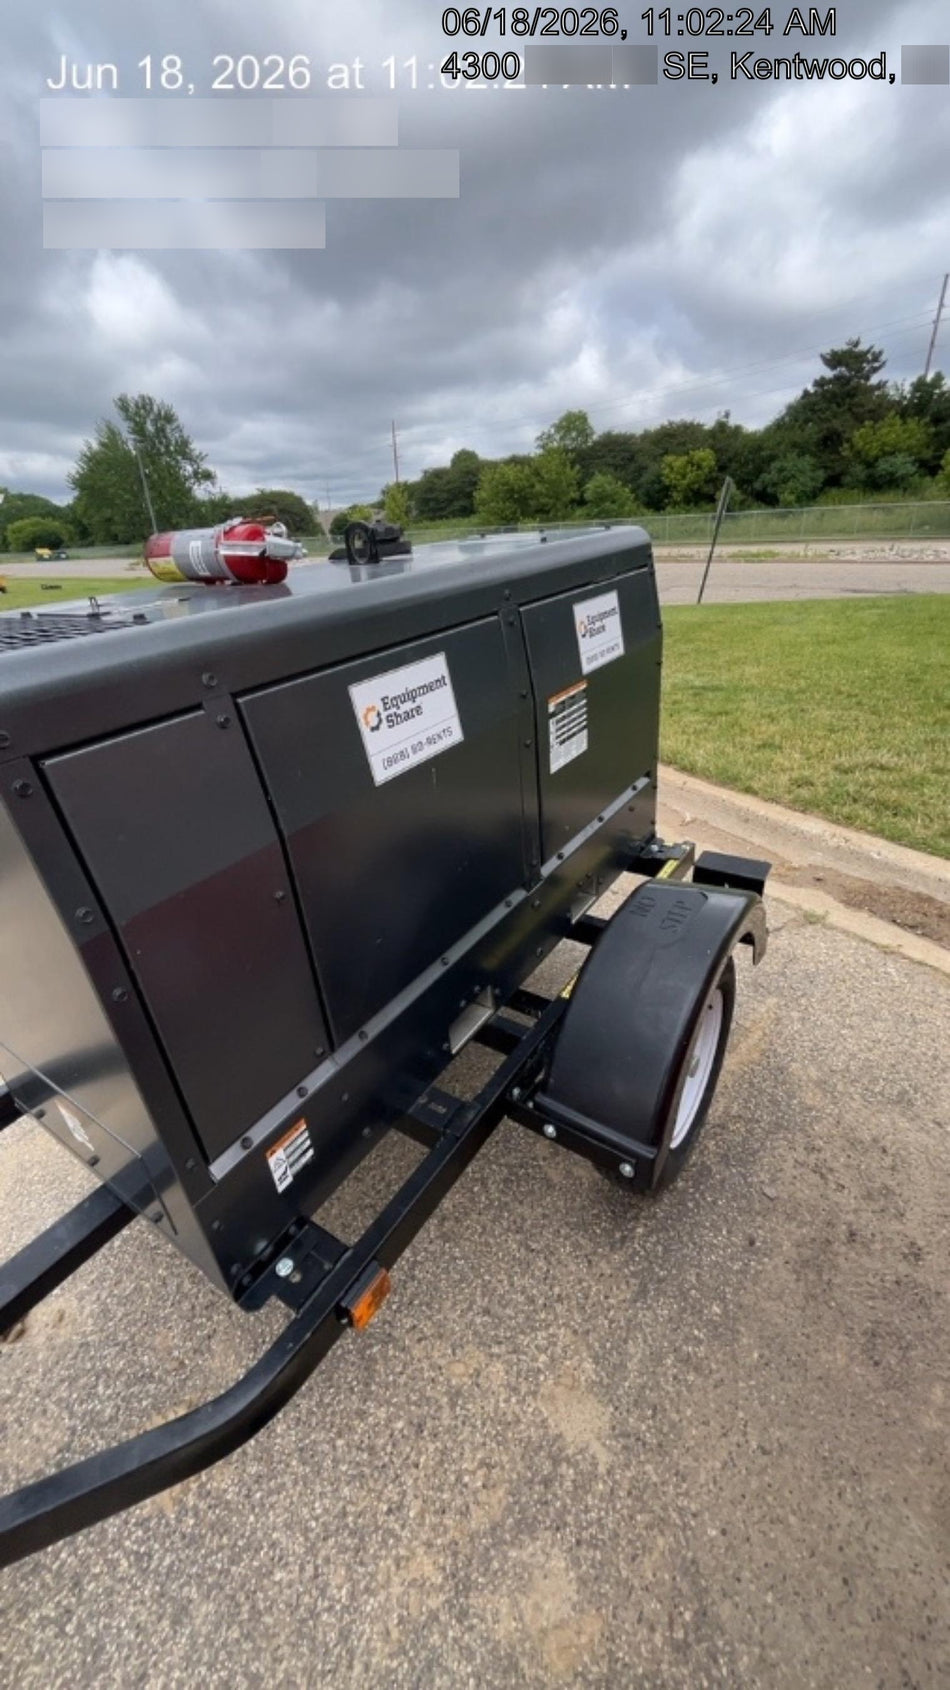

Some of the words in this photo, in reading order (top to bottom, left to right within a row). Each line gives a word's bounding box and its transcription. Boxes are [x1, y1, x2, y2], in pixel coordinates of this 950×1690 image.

[381, 674, 447, 711] Equipment
[385, 704, 424, 729] Share
[630, 895, 657, 918] NO
